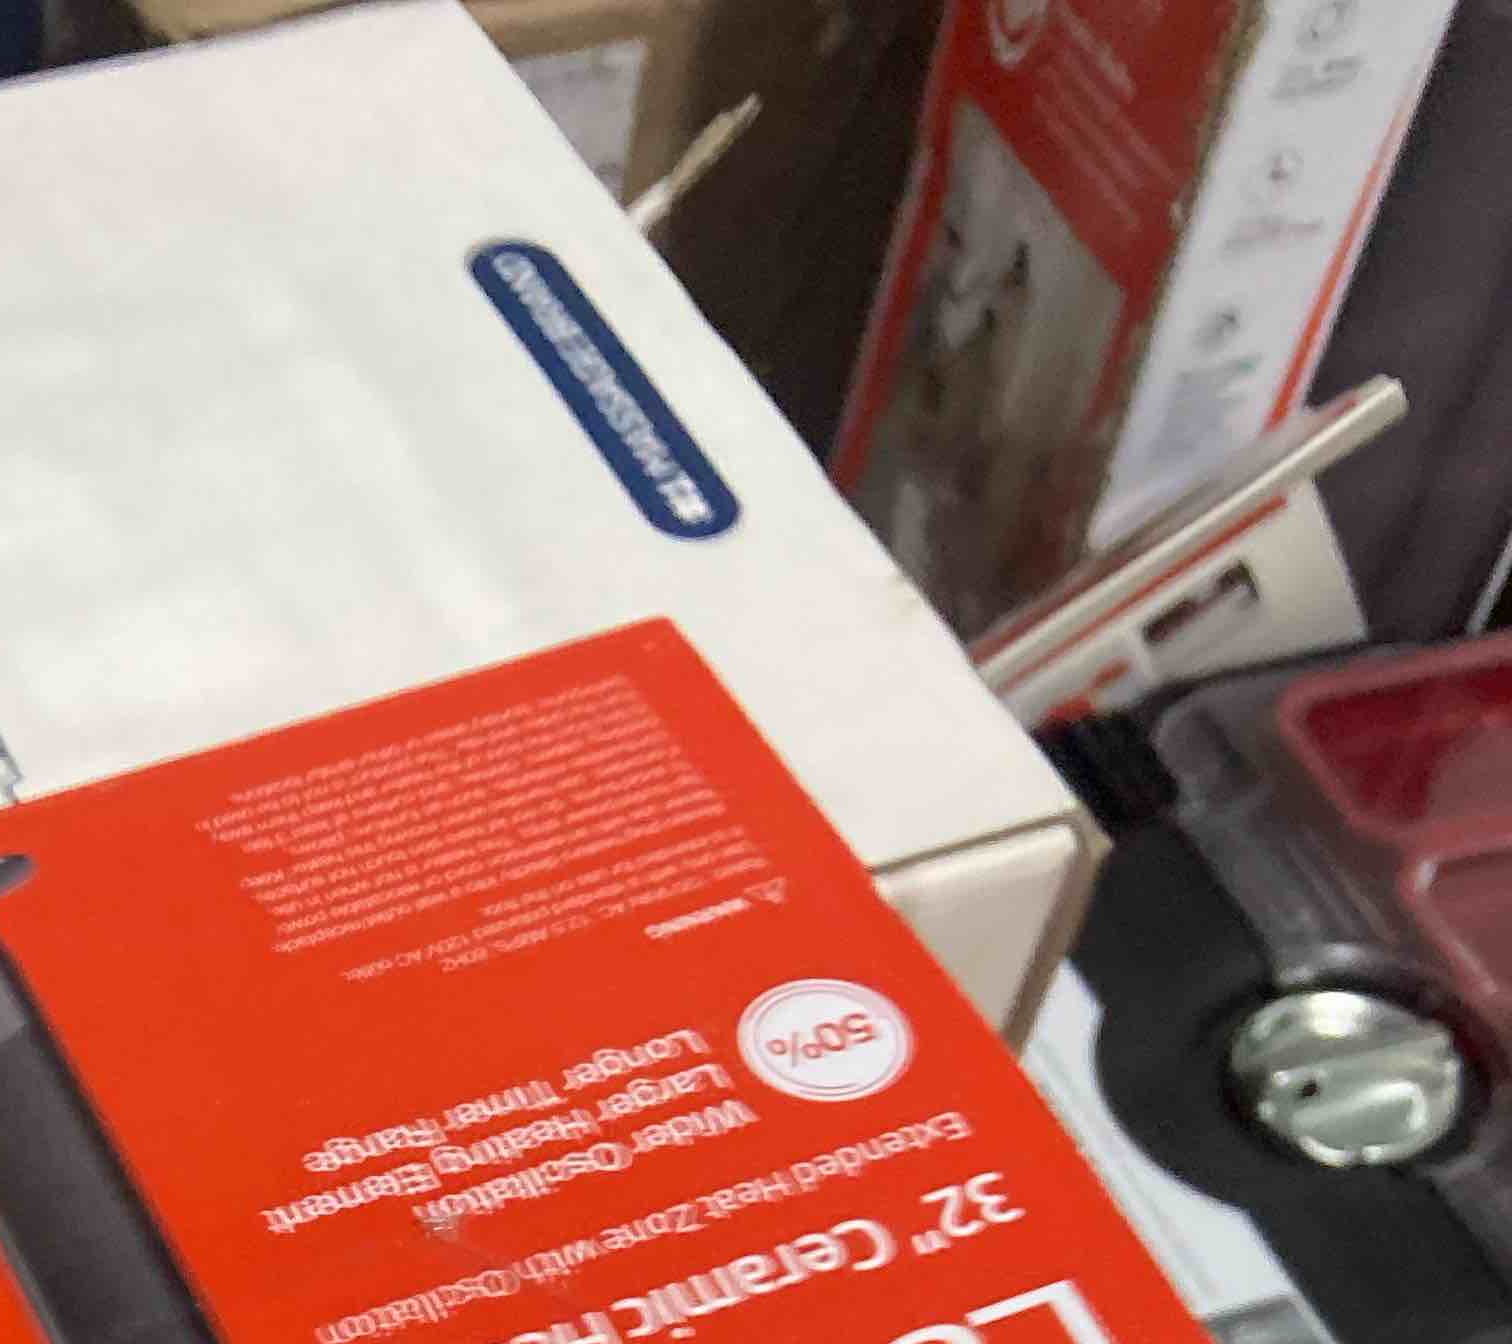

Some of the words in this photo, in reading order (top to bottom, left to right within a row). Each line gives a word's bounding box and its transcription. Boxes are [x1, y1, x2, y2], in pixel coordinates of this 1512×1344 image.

[561, 1027, 712, 1092] Longer
[764, 1011, 881, 1068] 50%
[443, 1078, 570, 1133] Timer
[598, 1062, 735, 1122] Larger
[302, 1116, 449, 1174] Range
[429, 1107, 601, 1177] Heating
[629, 1098, 761, 1157] Wider
[790, 1110, 972, 1193] Extended
[266, 1160, 444, 1234] Element
[412, 1140, 633, 1223] Oscillation
[696, 1175, 791, 1225] Heat
[598, 1203, 709, 1254] Zone
[910, 1171, 1029, 1256] 32"
[517, 1238, 604, 1288] with
[626, 1217, 901, 1339] Ceramic
